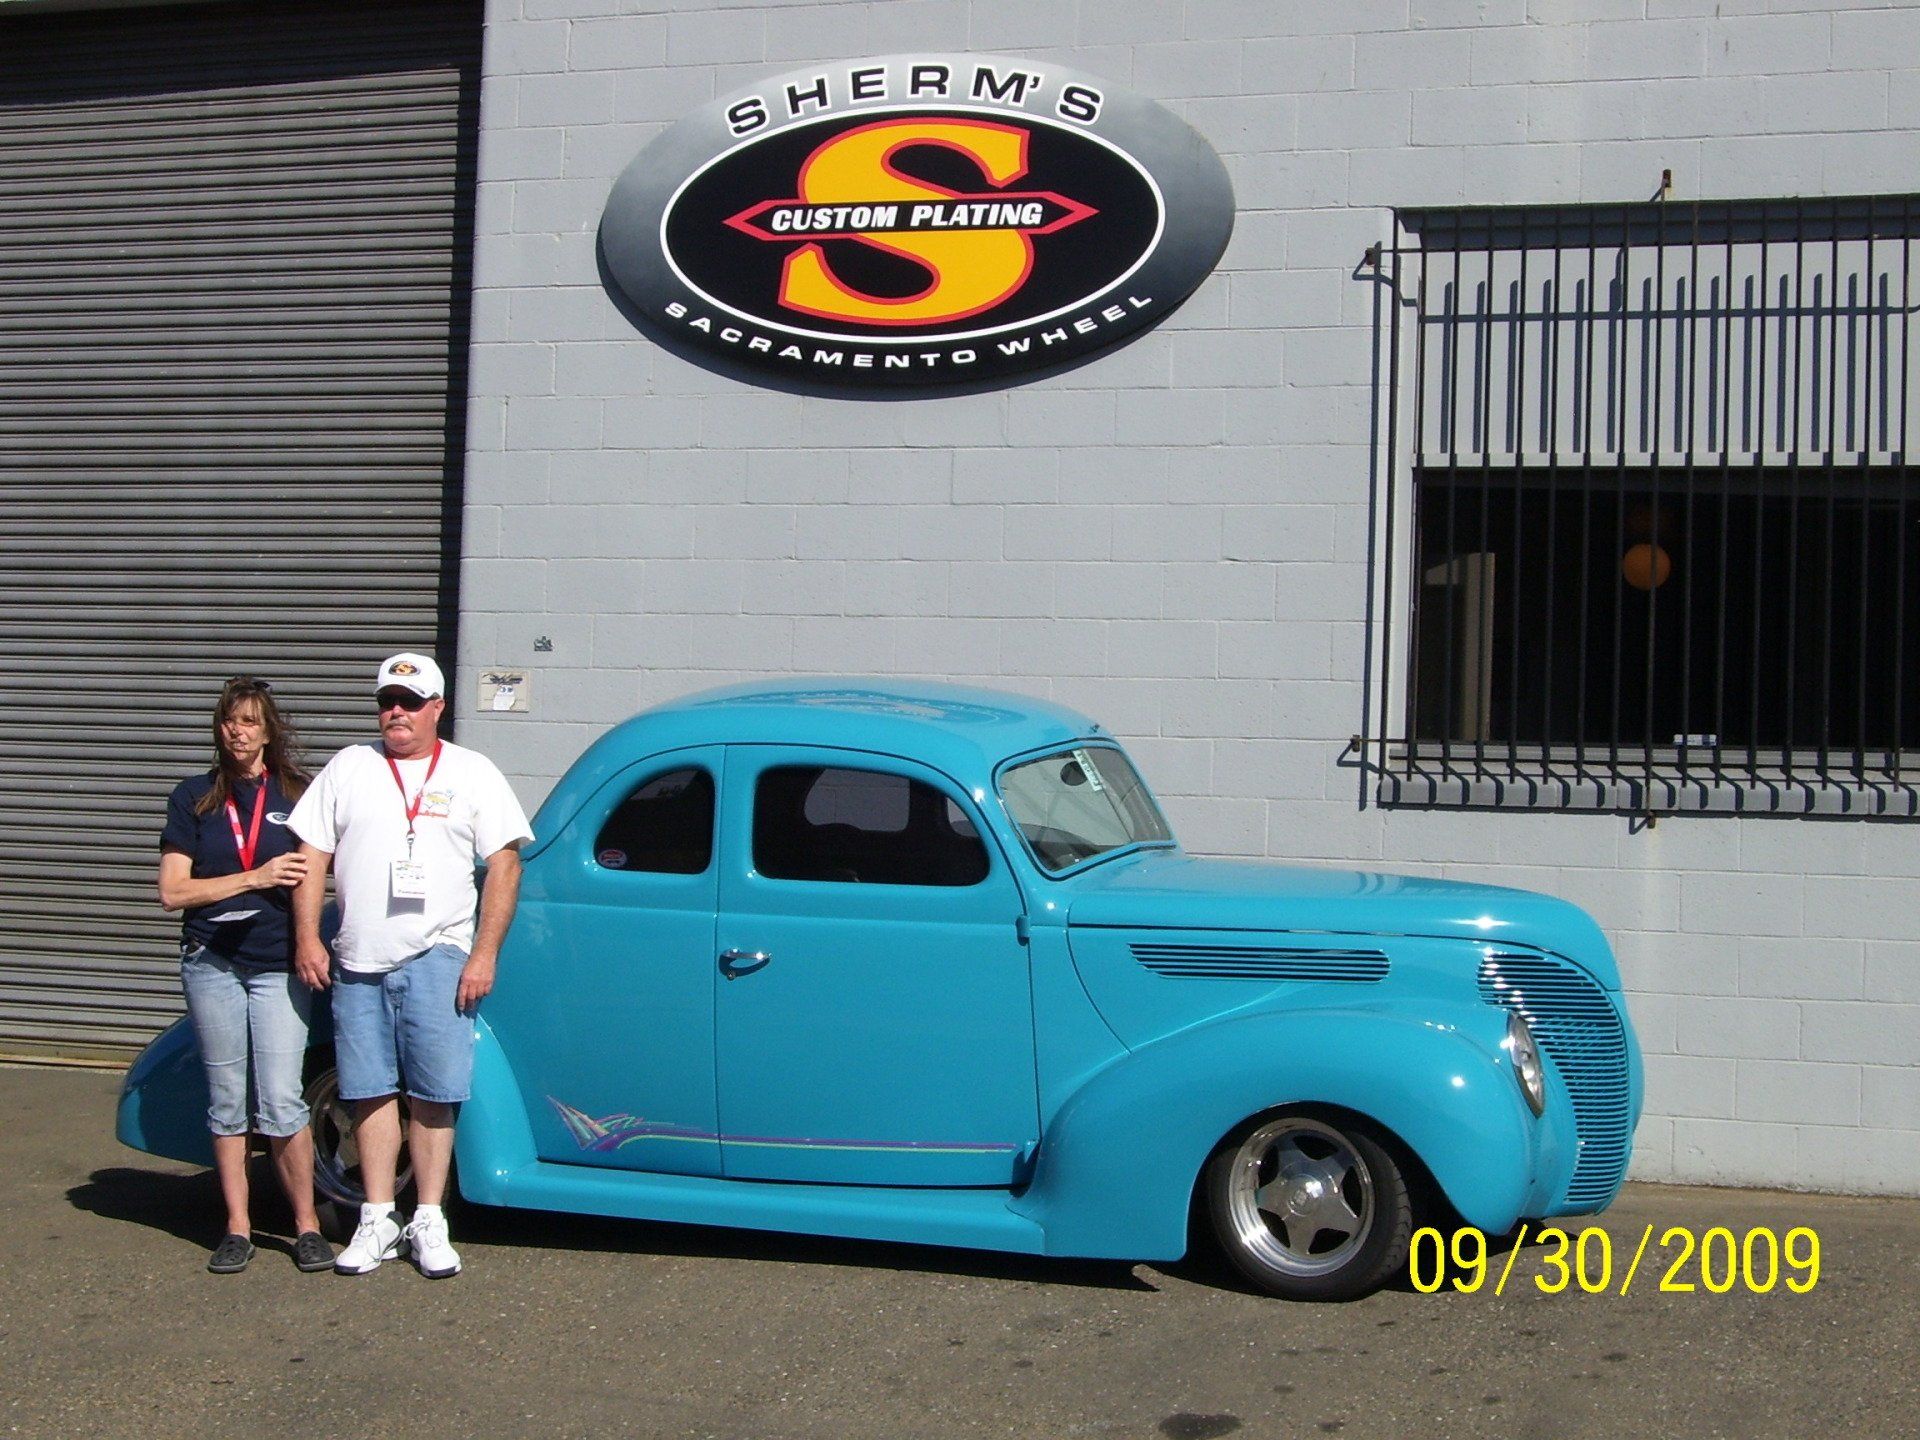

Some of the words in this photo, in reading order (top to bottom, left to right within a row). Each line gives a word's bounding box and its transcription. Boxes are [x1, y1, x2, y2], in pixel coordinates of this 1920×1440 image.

[728, 64, 1103, 136] SHERM'S
[770, 201, 897, 232] CUSTOM
[910, 202, 1043, 228] PLATING
[665, 302, 977, 368] SACRAMENTO
[997, 294, 1153, 357] WHEEL
